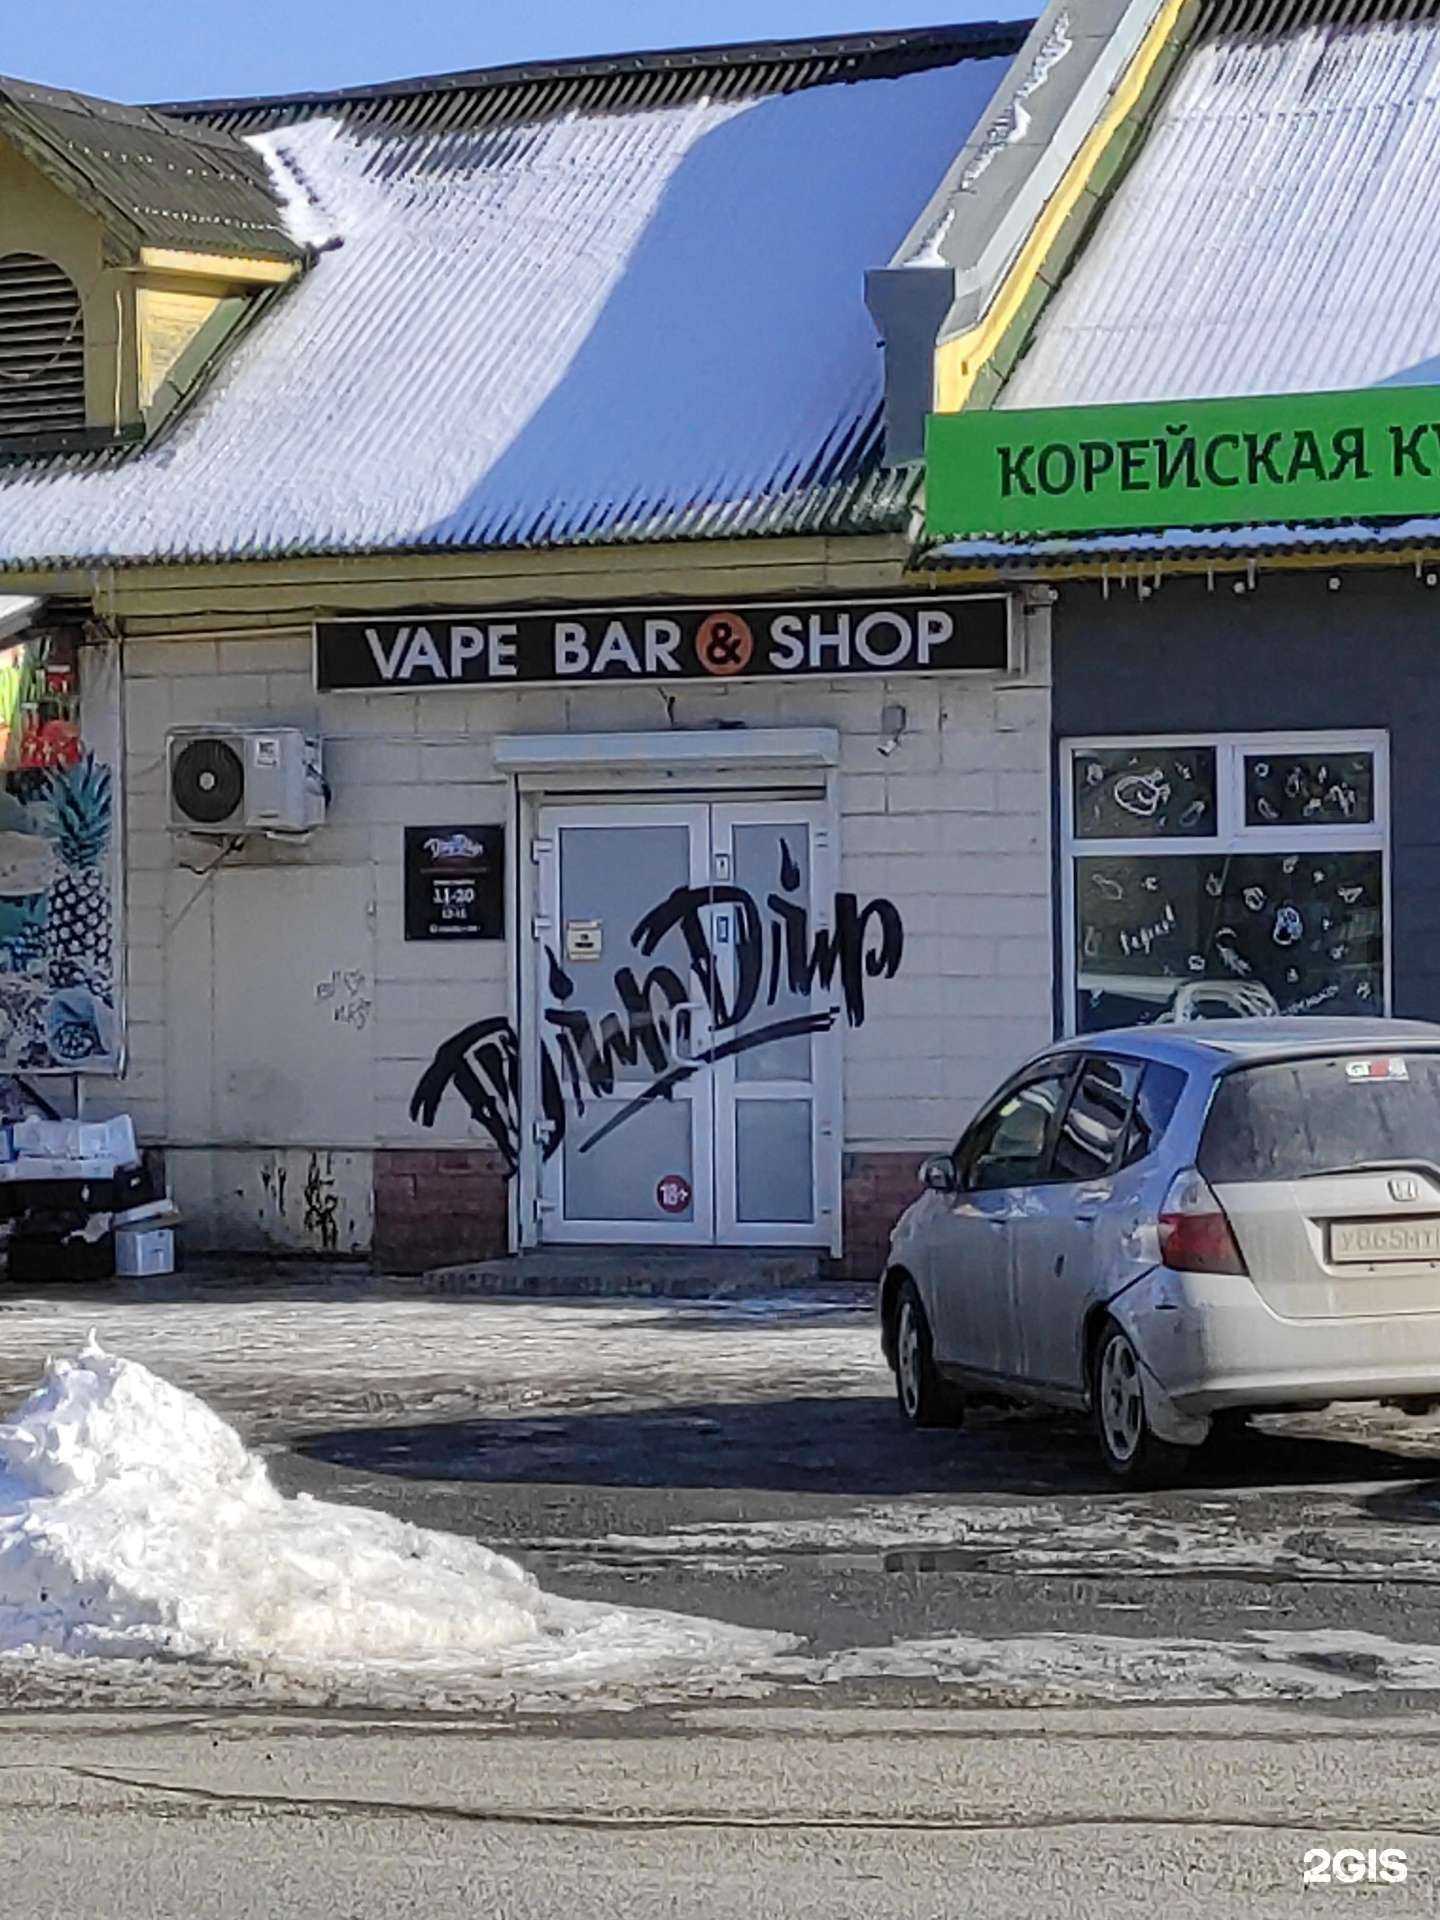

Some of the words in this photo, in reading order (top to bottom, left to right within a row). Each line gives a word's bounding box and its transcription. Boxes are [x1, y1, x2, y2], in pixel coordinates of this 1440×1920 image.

[996, 423, 1373, 498] КОРЕЙСКАЯ
[363, 624, 519, 679] VAPE
[553, 619, 682, 675] BAR
[705, 622, 746, 666] &
[768, 611, 954, 670] SHOP
[659, 1183, 689, 1205] 18+
